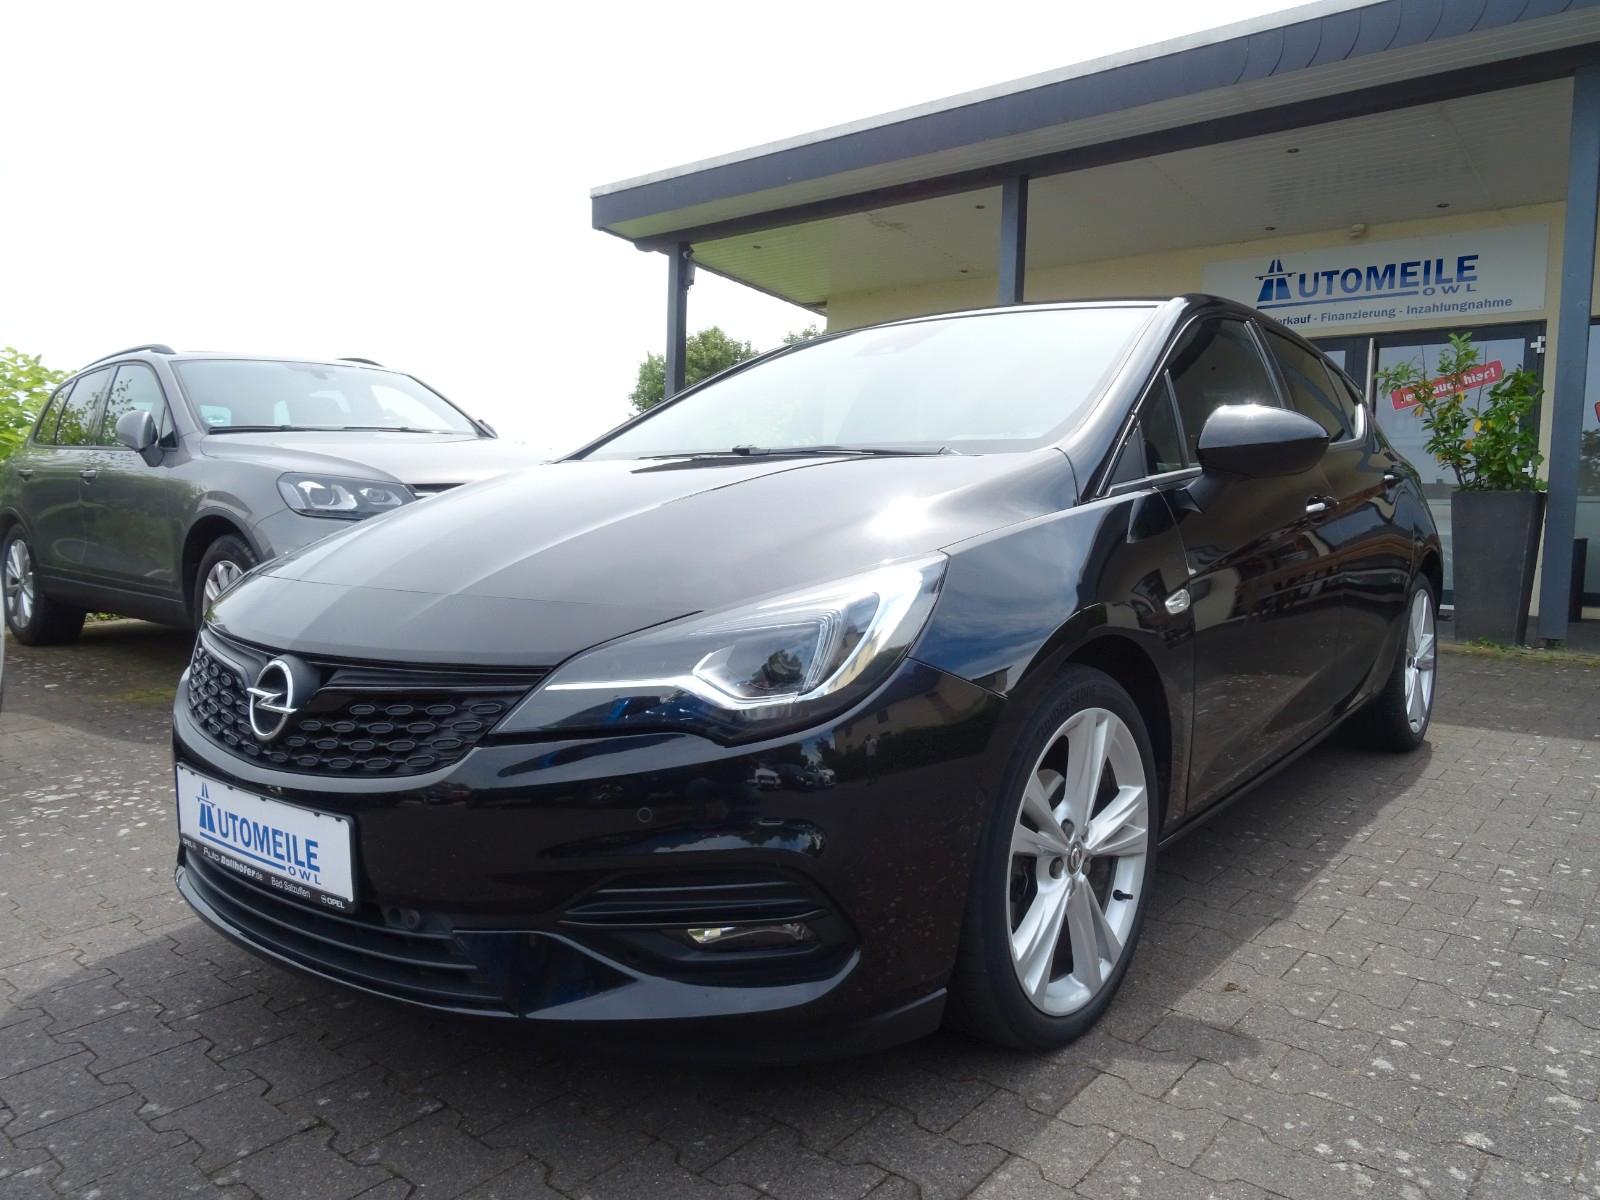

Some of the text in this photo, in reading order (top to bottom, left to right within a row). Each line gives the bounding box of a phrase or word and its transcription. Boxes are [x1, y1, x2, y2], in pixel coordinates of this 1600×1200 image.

[1255, 254, 1479, 303] AUTOMEILE
[1422, 283, 1478, 296] OWL
[1276, 313, 1312, 326] erkauf
[1320, 307, 1396, 323] Finanzierung
[1406, 298, 1513, 316] Inzahlungnahme
[1463, 367, 1495, 385] hier!
[195, 782, 321, 873] AUTOMEILE
[288, 866, 321, 885] OWL
[327, 897, 345, 909] OPEL
